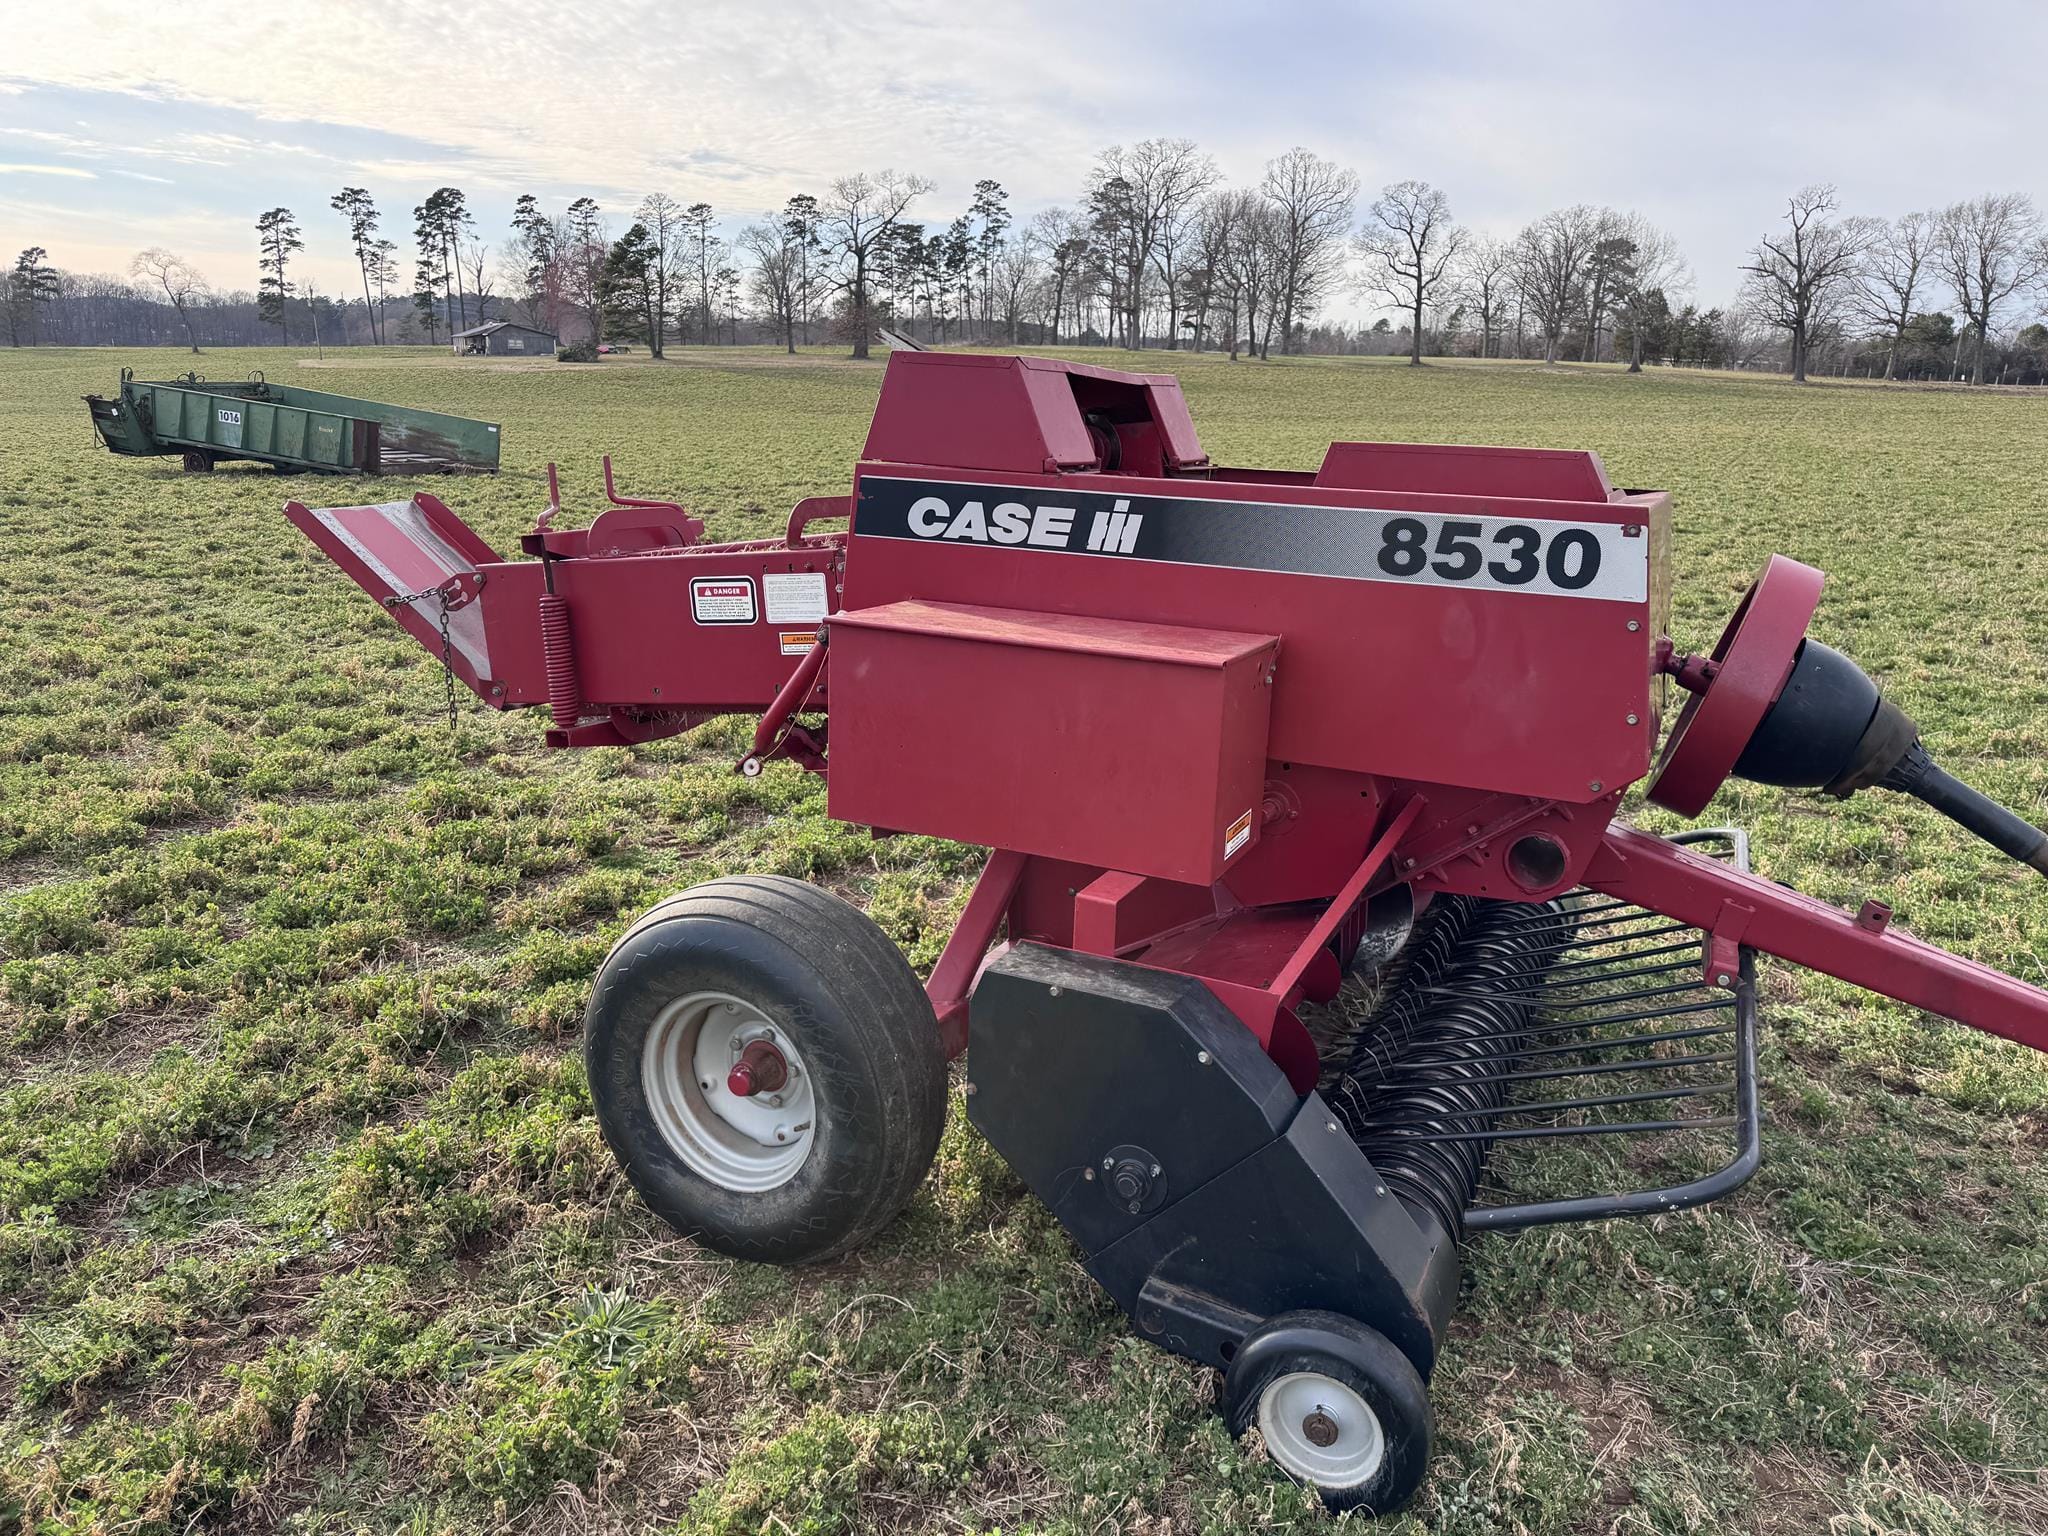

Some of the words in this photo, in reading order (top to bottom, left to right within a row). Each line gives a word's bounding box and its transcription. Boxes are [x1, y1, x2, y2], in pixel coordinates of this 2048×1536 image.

[219, 410, 240, 423] 1016
[907, 496, 1076, 548] CASE
[1377, 517, 1602, 591] 8530
[713, 587, 740, 595] DANGER
